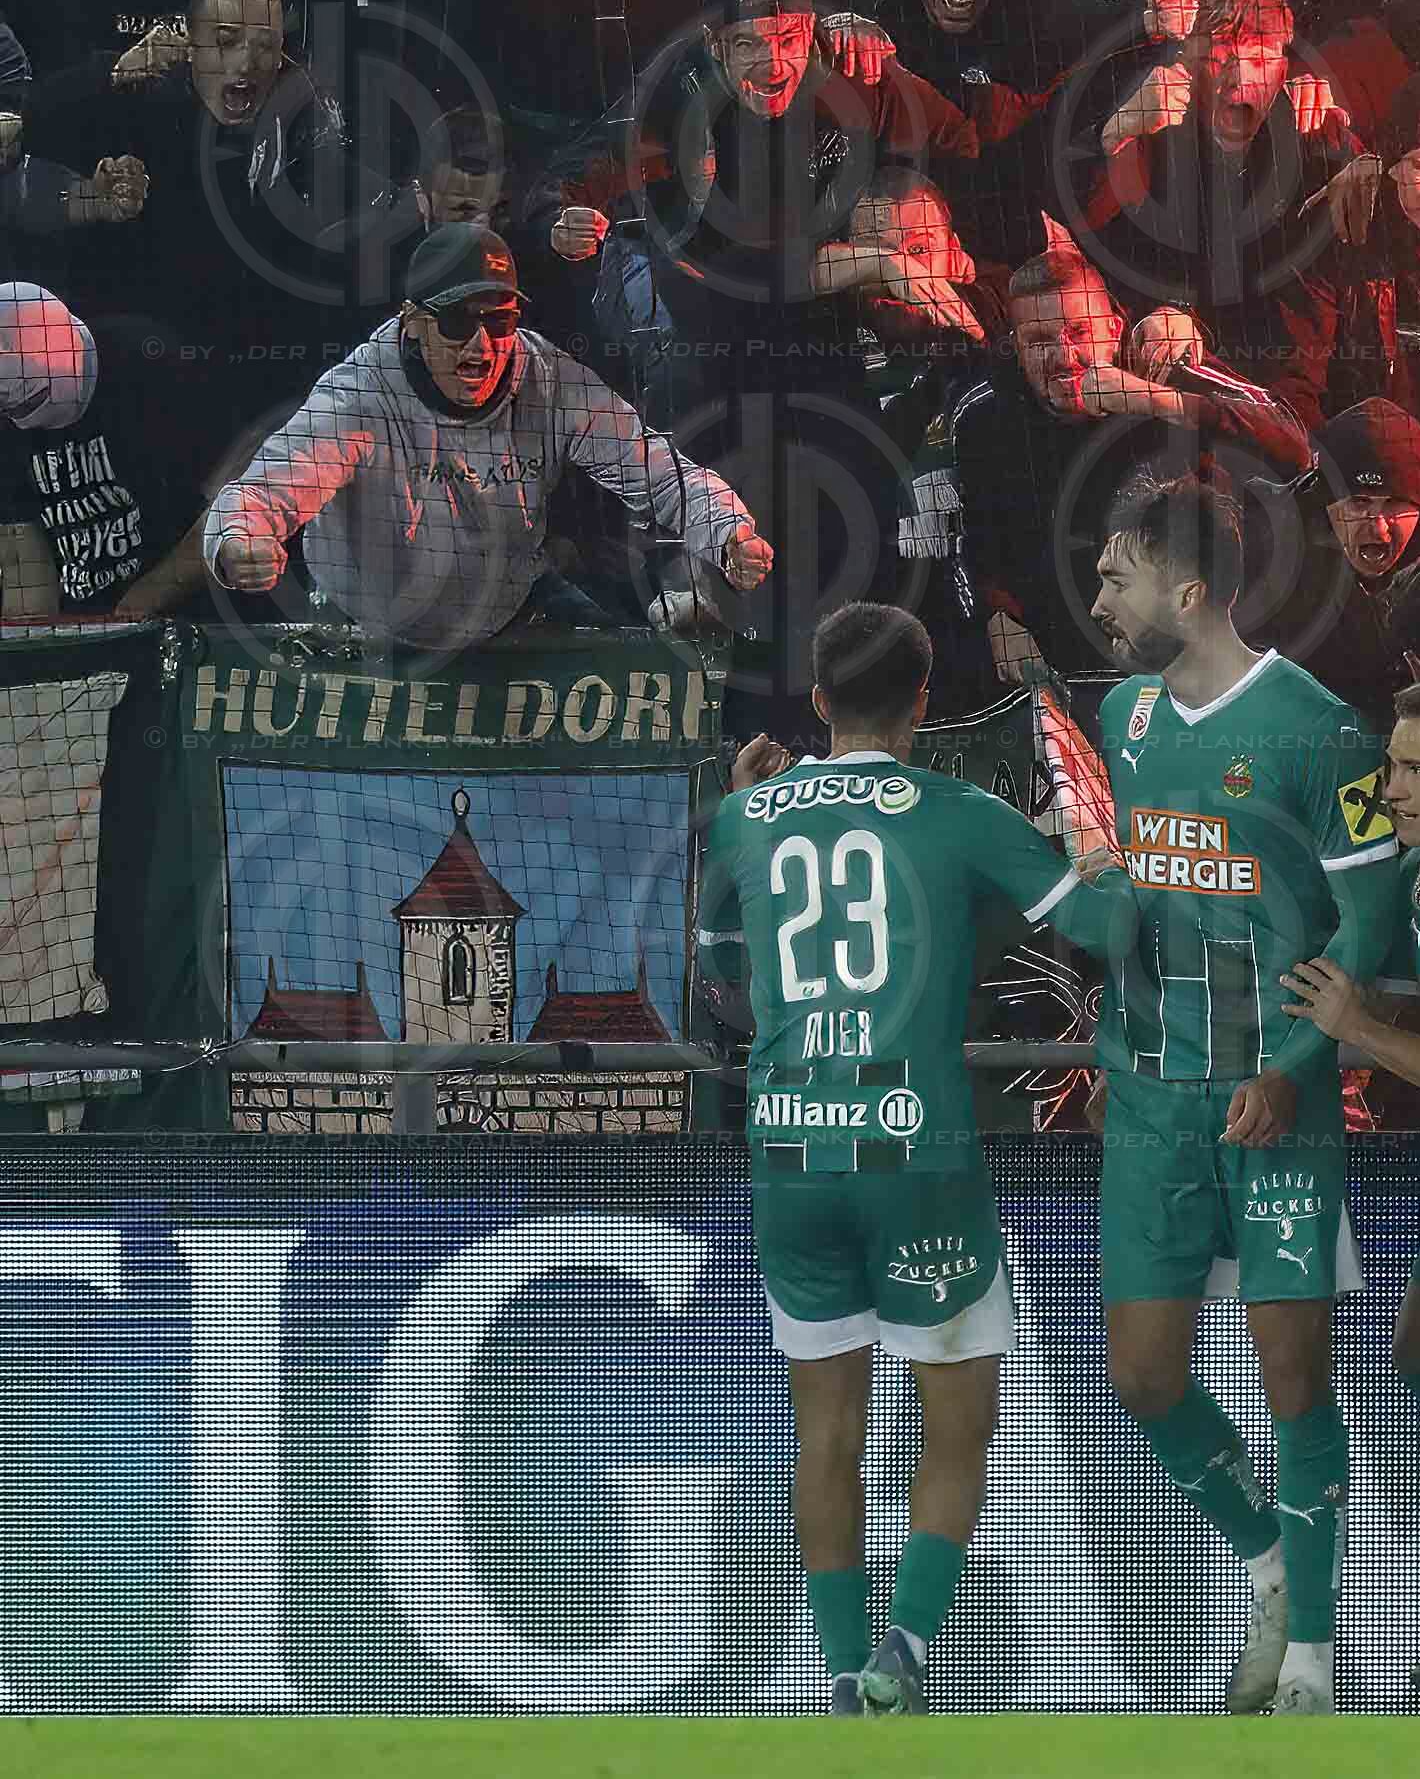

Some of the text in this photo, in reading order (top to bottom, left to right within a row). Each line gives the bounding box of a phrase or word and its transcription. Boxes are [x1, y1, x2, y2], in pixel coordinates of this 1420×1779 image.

[1135, 812, 1224, 852] WIEN
[770, 829, 889, 1003] 23
[752, 1093, 869, 1128] Allianz
